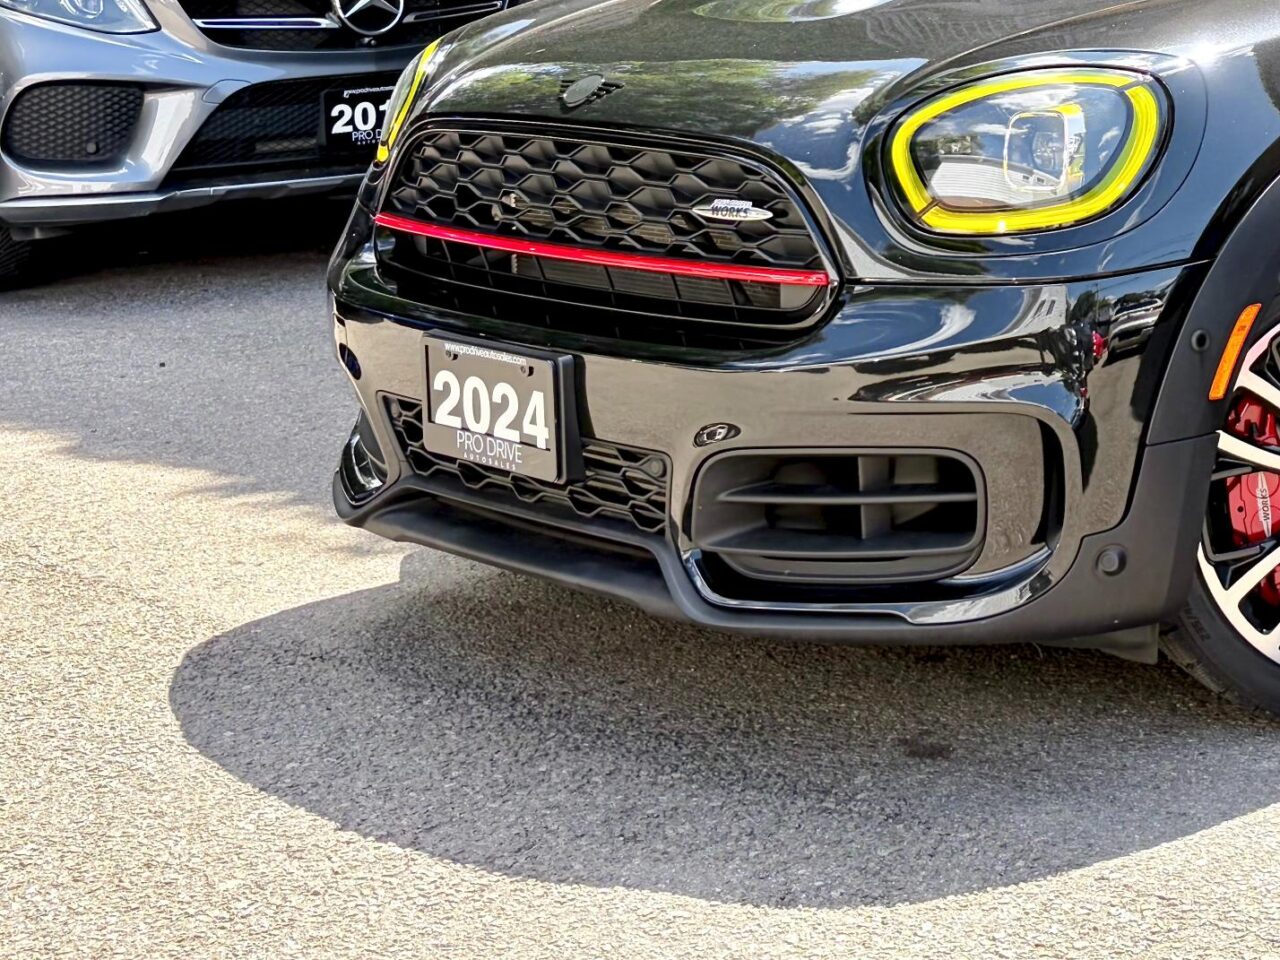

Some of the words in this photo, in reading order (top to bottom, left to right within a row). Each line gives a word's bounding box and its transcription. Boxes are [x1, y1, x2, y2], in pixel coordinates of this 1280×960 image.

[352, 130, 374, 141] PRO
[711, 205, 751, 218] WORKS
[433, 369, 550, 450] 2024
[456, 430, 484, 453] PRO
[487, 437, 523, 463] DRIVE
[463, 452, 517, 471] AUTOSALES
[1260, 488, 1270, 521] WORKS
